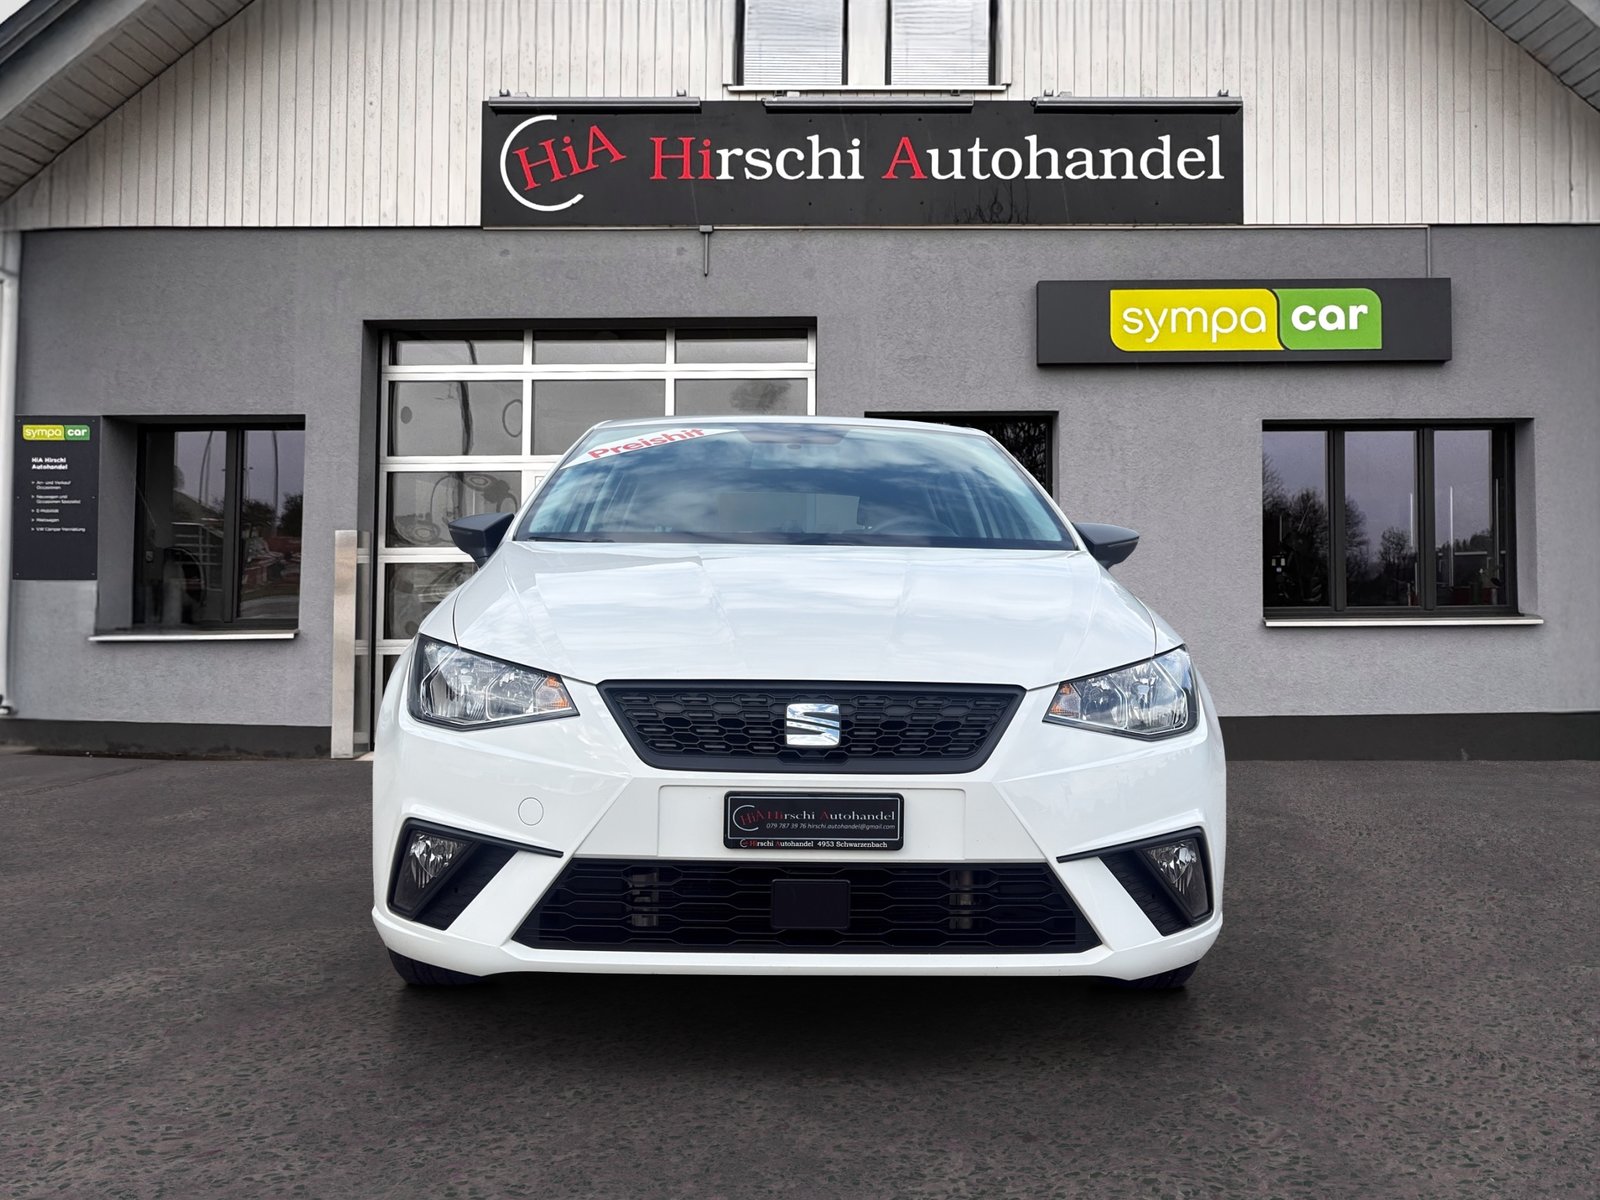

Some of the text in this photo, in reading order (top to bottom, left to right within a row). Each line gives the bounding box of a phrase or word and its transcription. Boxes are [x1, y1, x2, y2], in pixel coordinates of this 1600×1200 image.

[513, 124, 627, 191] HiA
[649, 134, 1224, 180] Hirschi Autohandel
[1122, 304, 1368, 343] sympa car
[25, 428, 87, 438] sympa car
[587, 427, 704, 459] Preishit
[767, 810, 895, 821] Hirschi Autohandel
[775, 840, 814, 848] Autohandel
